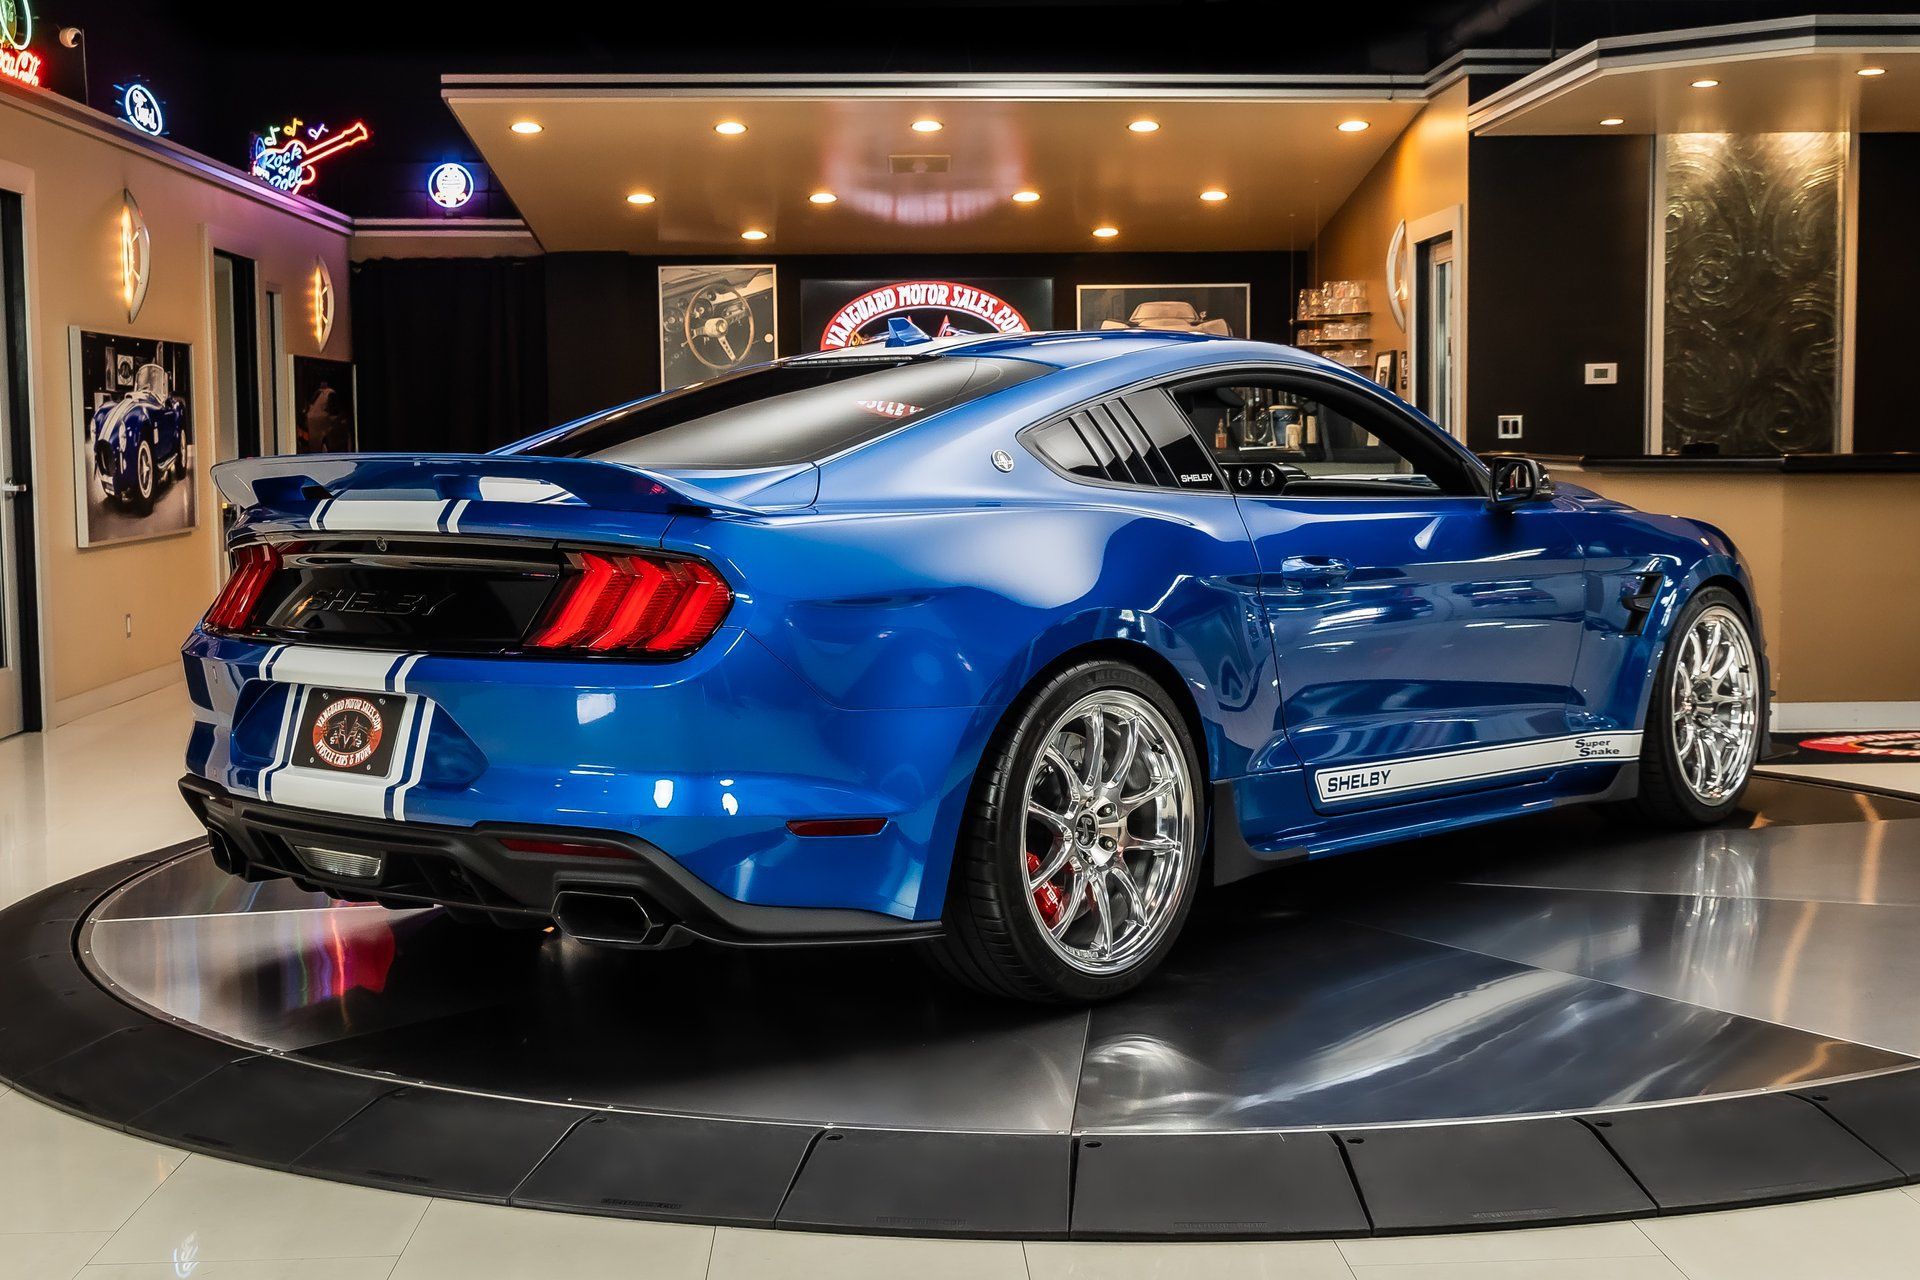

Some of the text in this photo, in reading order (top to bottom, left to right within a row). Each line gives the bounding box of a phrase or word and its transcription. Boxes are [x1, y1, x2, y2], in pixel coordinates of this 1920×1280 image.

[264, 143, 302, 170] Rock
[825, 288, 896, 347] VANGUARD
[897, 283, 950, 307] MOTOR
[1180, 473, 1213, 483] SHELBY
[305, 588, 457, 617] SHELBY
[316, 700, 345, 728] VANGUARD
[344, 698, 363, 710] MOTOR
[315, 739, 336, 763] MUSCLE
[333, 753, 349, 766] CARS
[349, 753, 356, 766] &
[1574, 738, 1611, 748] Super
[1578, 747, 1620, 757] Snake
[1327, 769, 1391, 793] SHELBY
